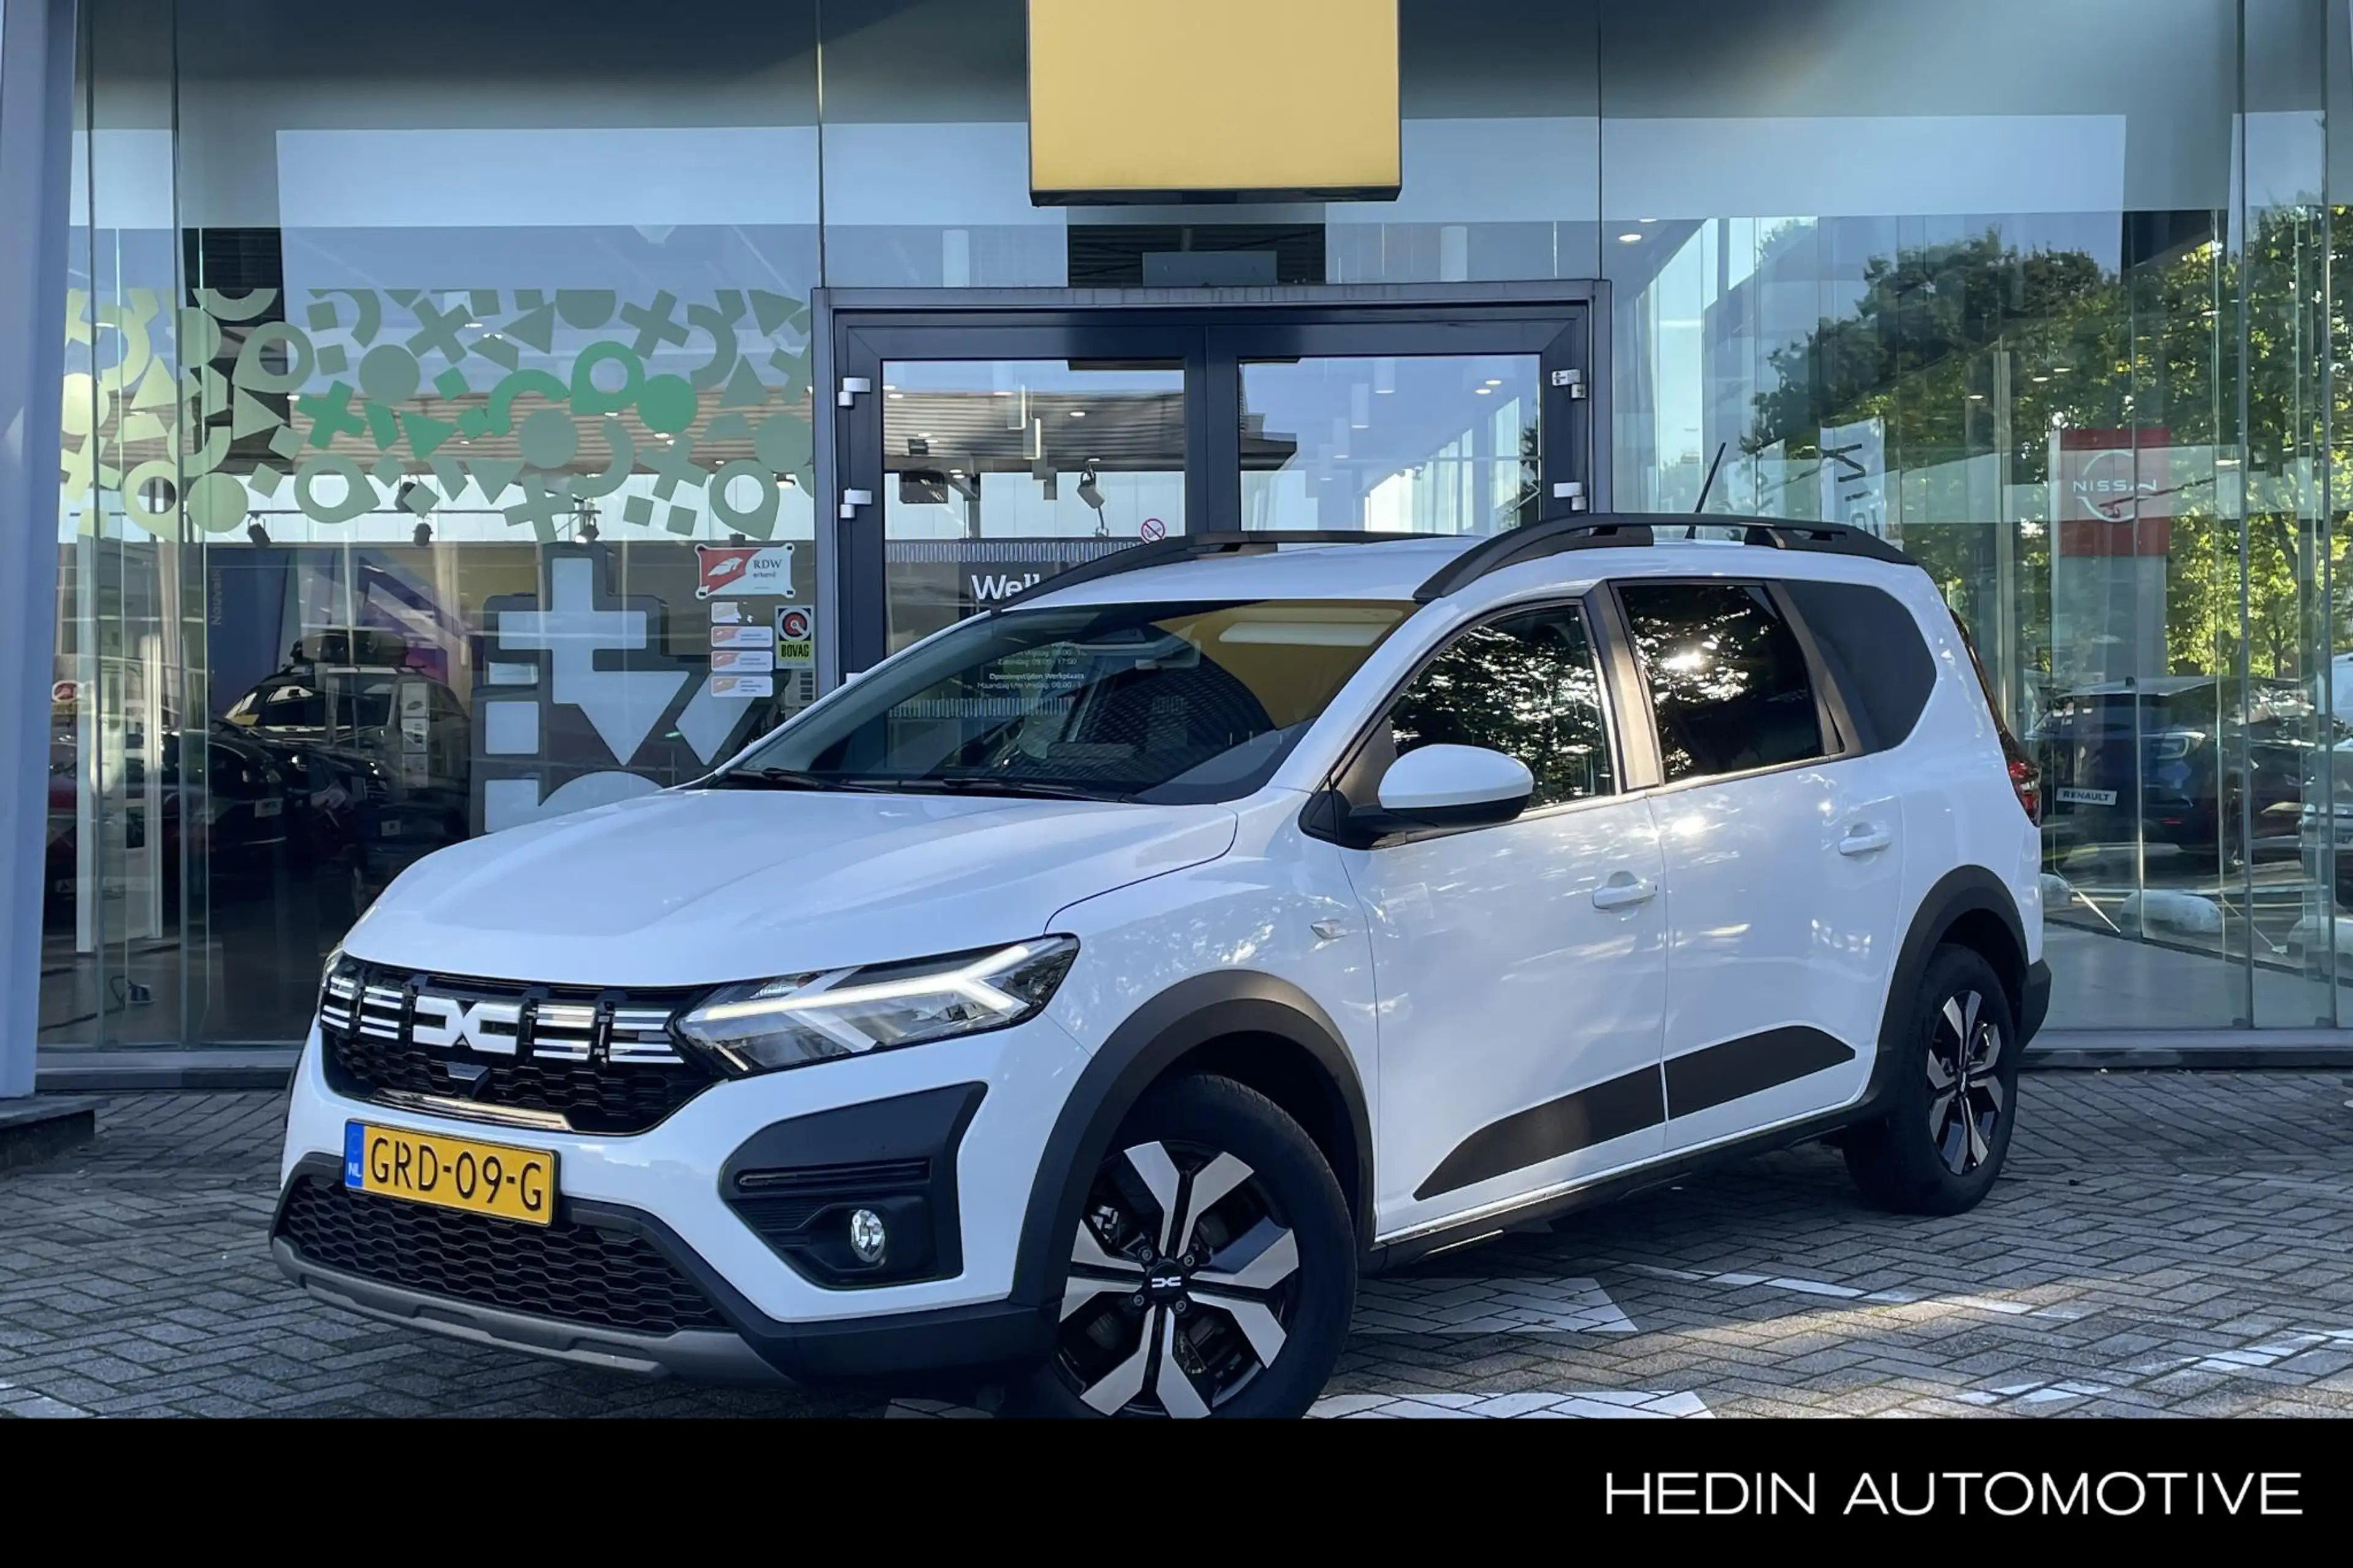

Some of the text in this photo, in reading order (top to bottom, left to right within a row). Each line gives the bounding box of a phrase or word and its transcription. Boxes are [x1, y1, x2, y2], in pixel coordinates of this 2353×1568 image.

[2072, 479, 2157, 493] NISSAN
[753, 559, 782, 569] RDW
[781, 644, 809, 657] BOVAG
[2063, 790, 2110, 801] RENAULT
[348, 1162, 362, 1178] NL
[371, 1137, 543, 1211] GRD-09-G
